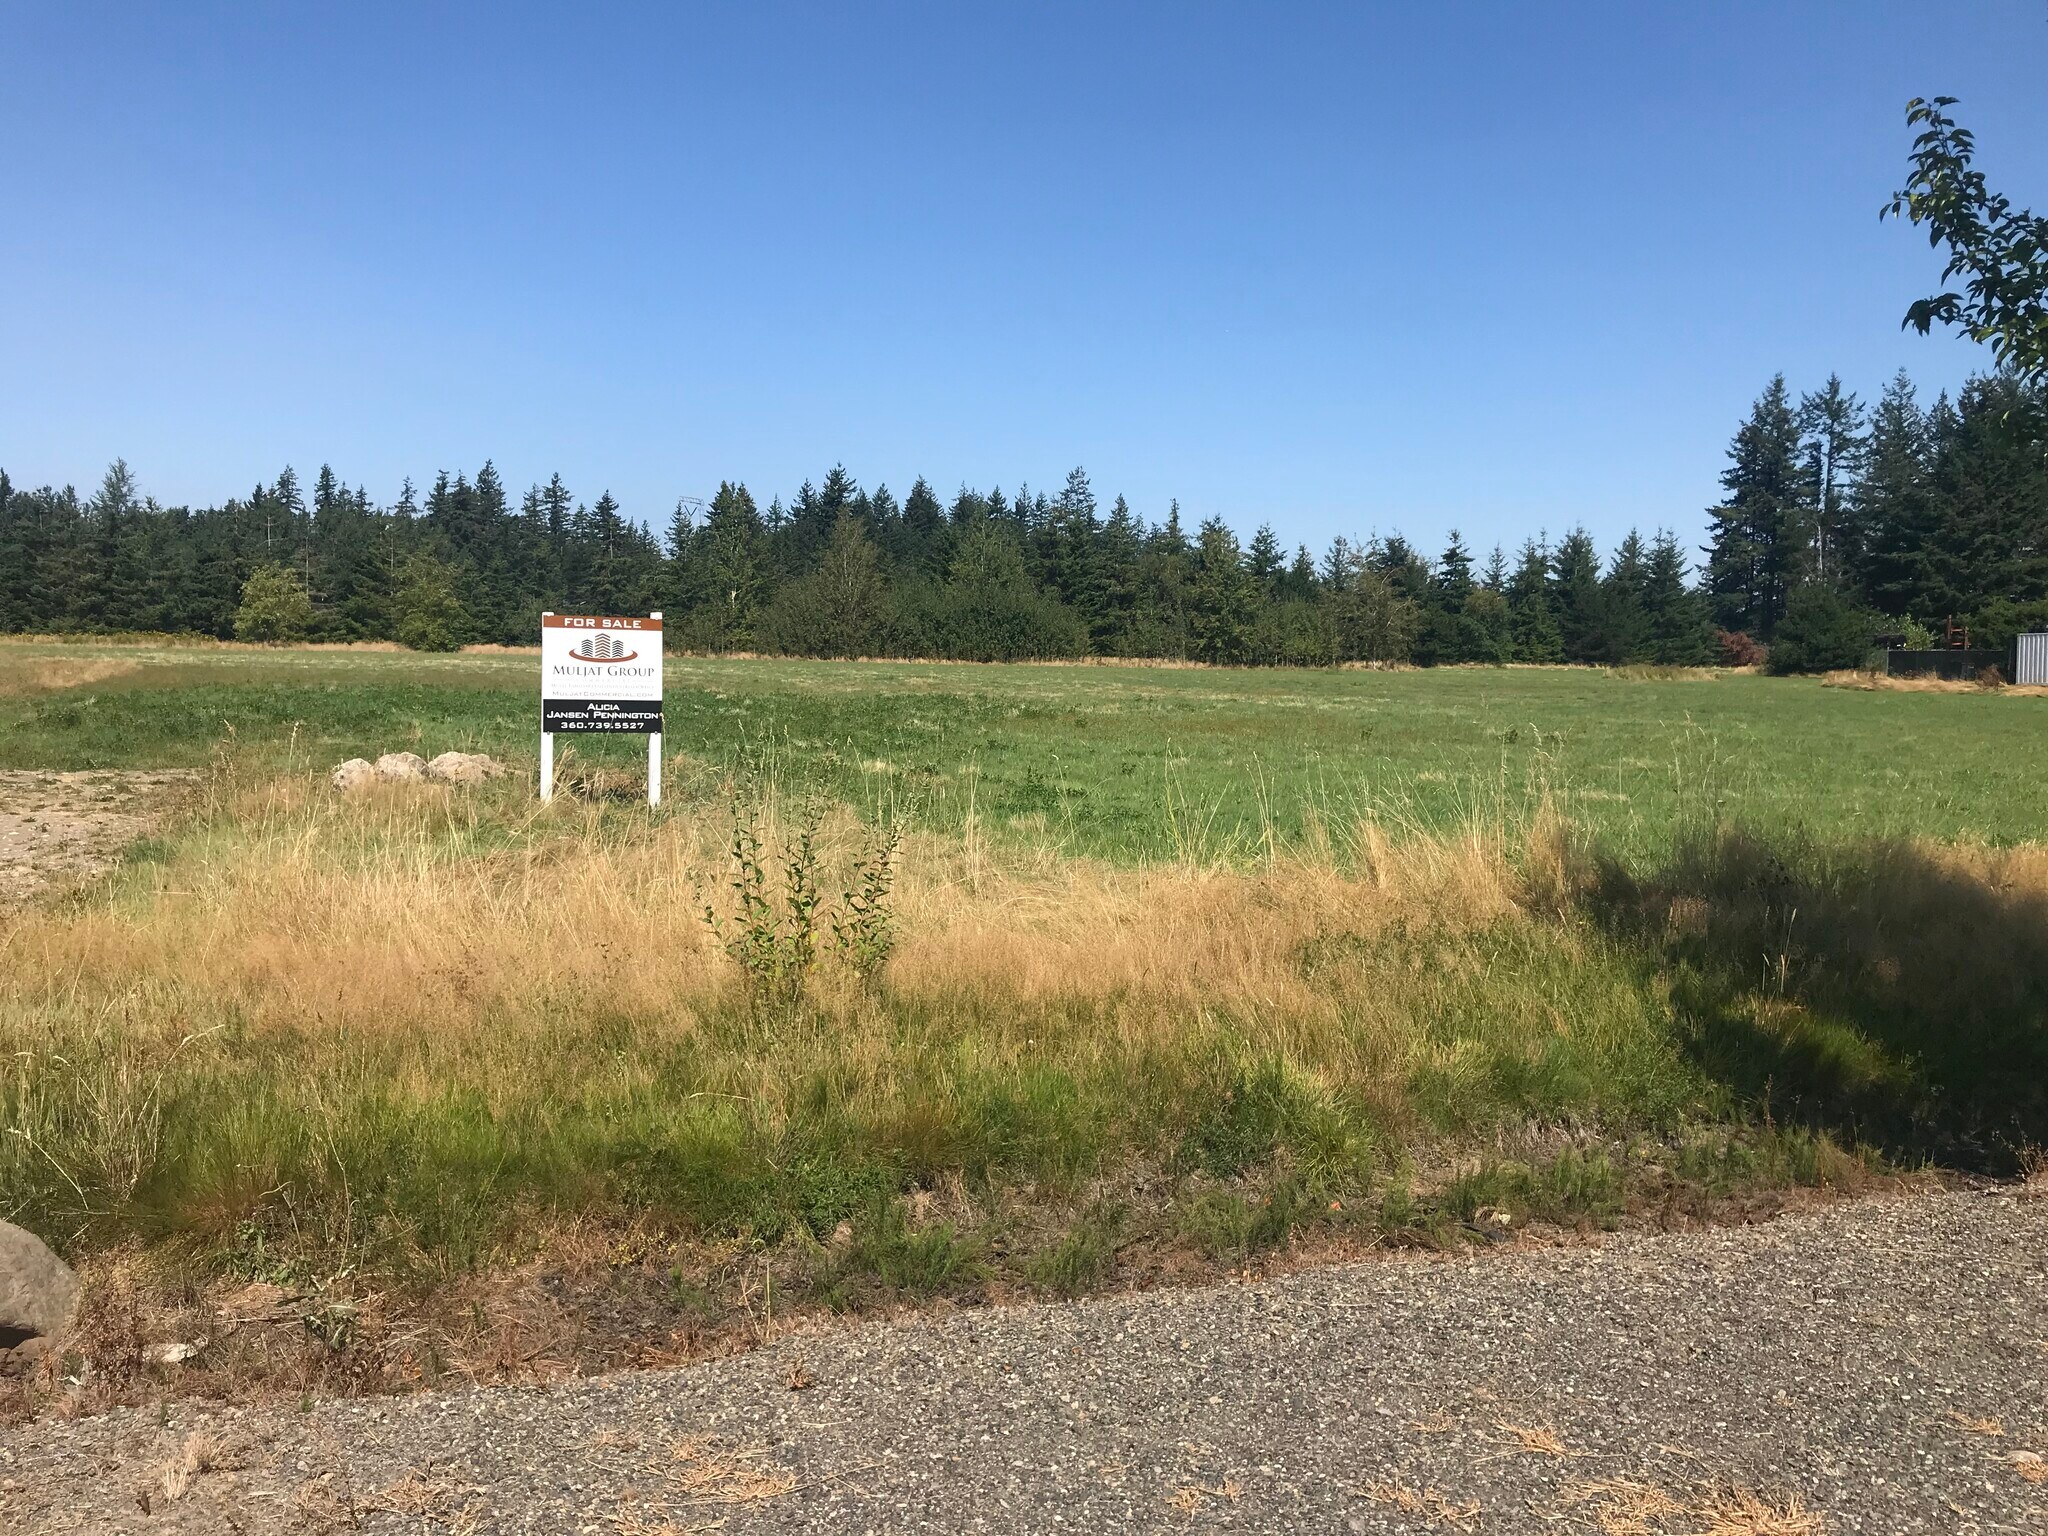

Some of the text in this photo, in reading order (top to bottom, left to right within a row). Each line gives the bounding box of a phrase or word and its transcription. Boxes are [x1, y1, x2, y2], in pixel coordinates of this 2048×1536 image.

[564, 618, 641, 628] FOR SALE
[552, 665, 654, 677] MULJAT GROUP
[587, 703, 620, 711] ALICIA
[546, 711, 659, 719] JANSEN PENNINGTON
